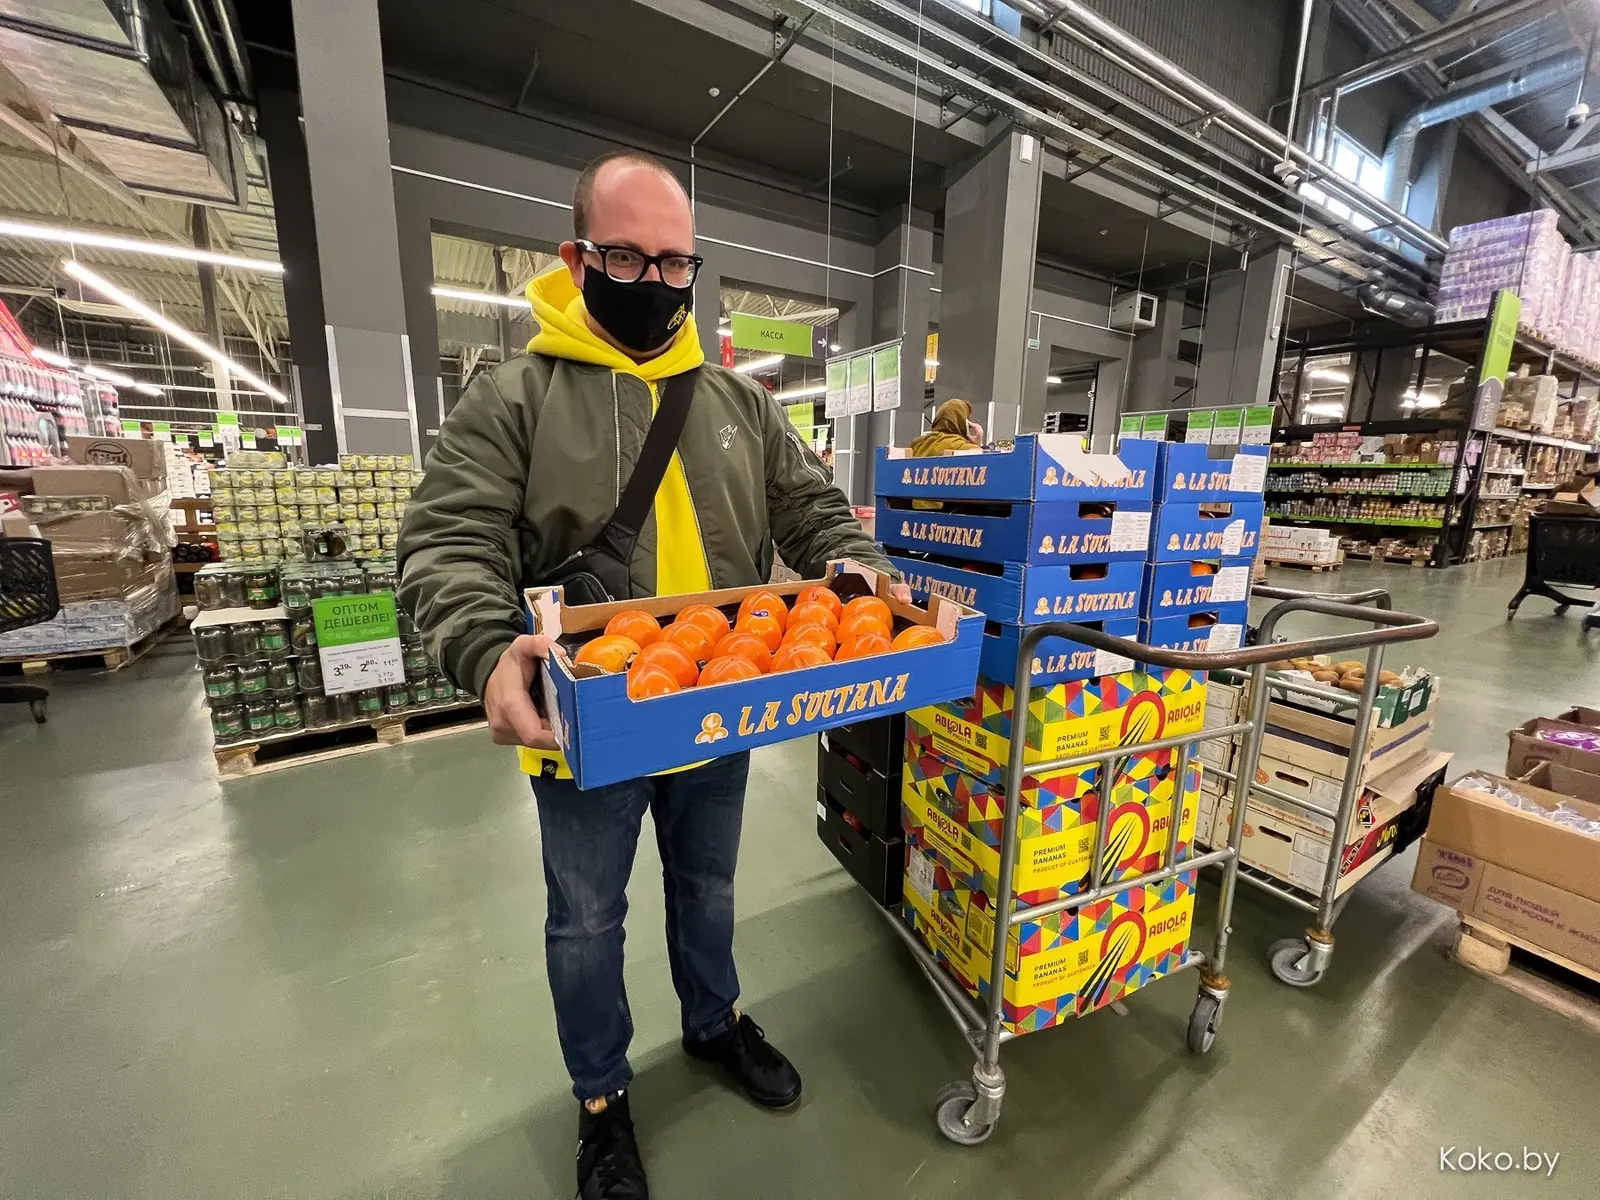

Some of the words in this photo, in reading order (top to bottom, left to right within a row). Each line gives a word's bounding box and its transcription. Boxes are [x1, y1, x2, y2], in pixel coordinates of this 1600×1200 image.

[760, 330, 784, 340] КАССА
[914, 467, 930, 486] LA
[931, 465, 988, 486] SULTANA
[1189, 472, 1208, 491] LA
[912, 522, 928, 540] LA
[928, 523, 984, 548] SULTANA
[1183, 533, 1202, 551] LA
[1058, 535, 1080, 554] LA
[909, 573, 923, 592] LA
[1053, 596, 1074, 615] LA
[1075, 591, 1136, 613] SULTANA
[1175, 588, 1194, 606] LA
[332, 602, 379, 616] ОПТОМ
[324, 612, 390, 631] ДЕШЕВЛЕ!
[1047, 655, 1068, 674] LA
[737, 700, 782, 737] LA
[786, 672, 910, 726] SULTANA
[1167, 701, 1201, 724] ABIOLA
[935, 713, 972, 738] ABIOLA
[1057, 731, 1089, 742] PREMIUM
[1056, 740, 1089, 752] BANANAS
[927, 808, 959, 839] ABIOLA
[1033, 844, 1066, 856] PREMIUM
[1033, 852, 1067, 865] BANANAS
[1033, 862, 1059, 874] PRODUCT
[1487, 886, 1513, 900] ДЛЯ
[1149, 911, 1187, 938] ABIOLA
[1033, 966, 1067, 980] BANANAS
[1034, 958, 1067, 972] PREMIUM
[1033, 976, 1058, 988] PRODUCT
